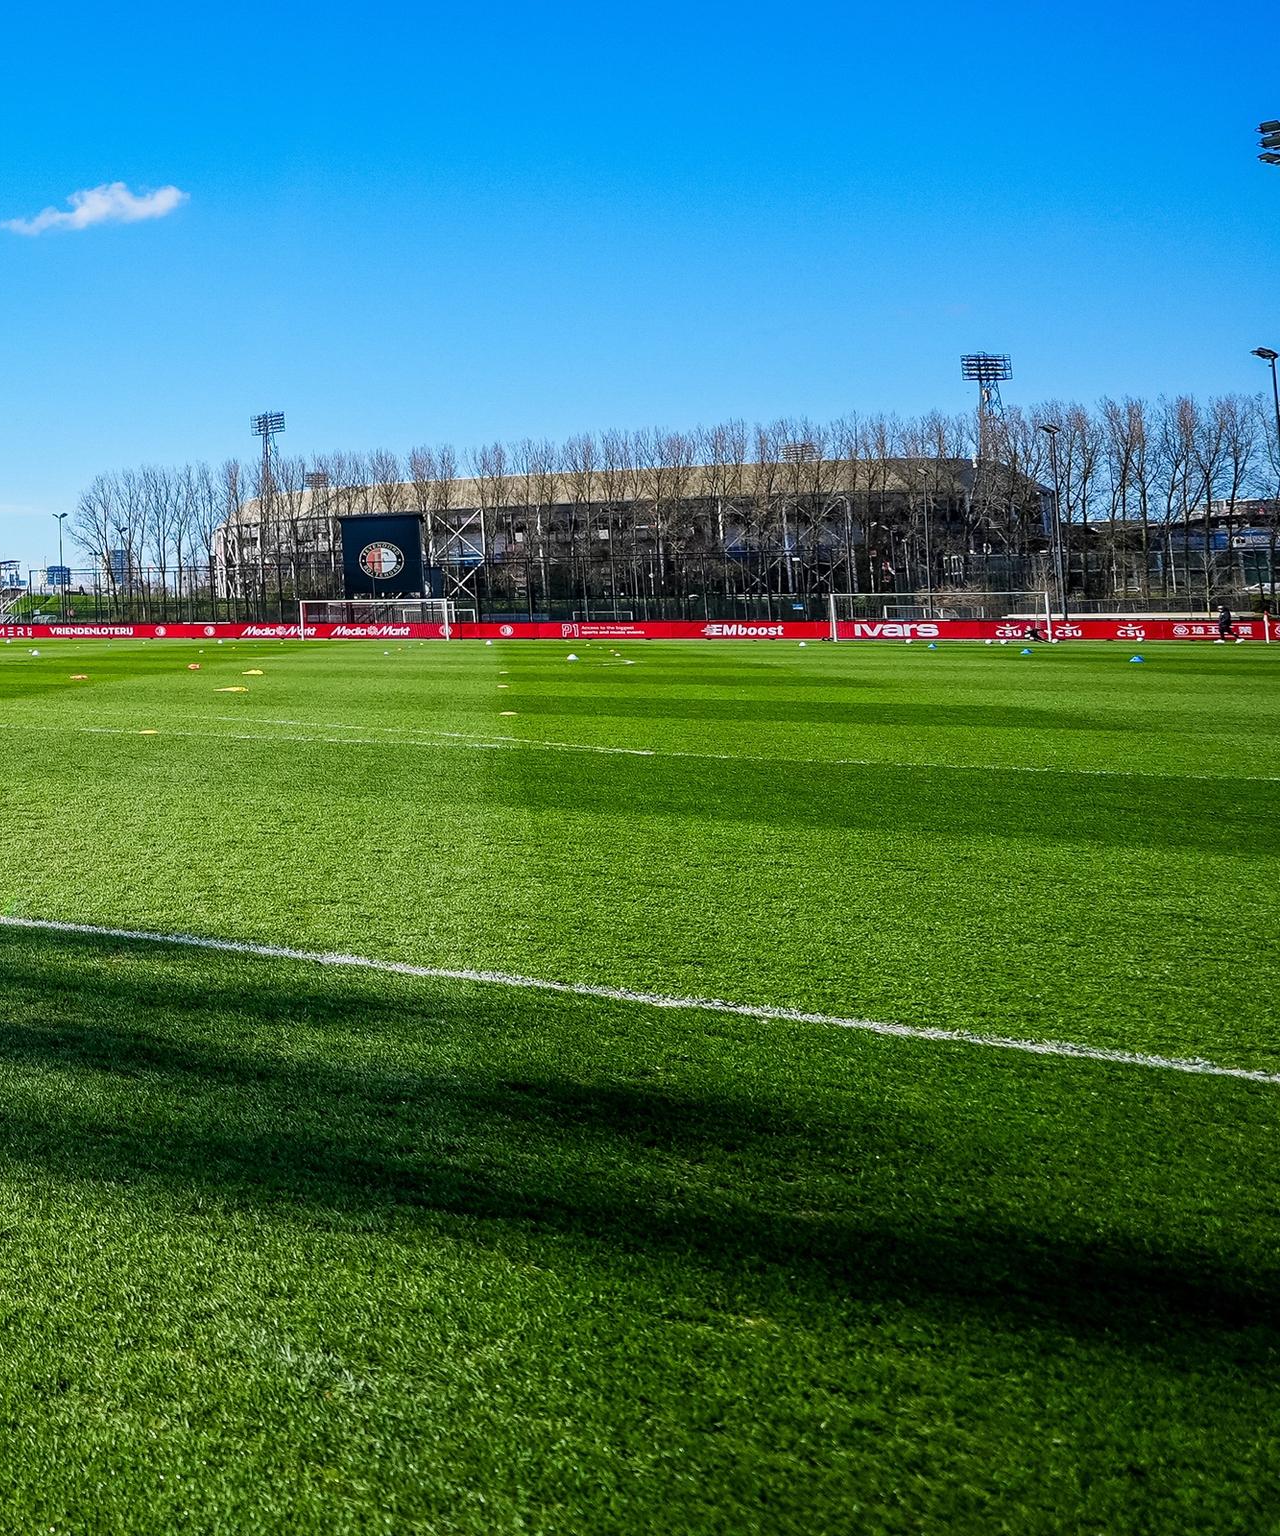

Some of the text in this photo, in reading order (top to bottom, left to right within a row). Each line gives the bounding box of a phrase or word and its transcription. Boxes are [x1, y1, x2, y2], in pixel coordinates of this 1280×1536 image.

[49, 627, 133, 636] VRIENDENLOTERIJ
[707, 624, 784, 636] EMboost
[995, 629, 1022, 637] CSU
[1055, 629, 1083, 637] CSU
[1116, 629, 1145, 637] CSU
